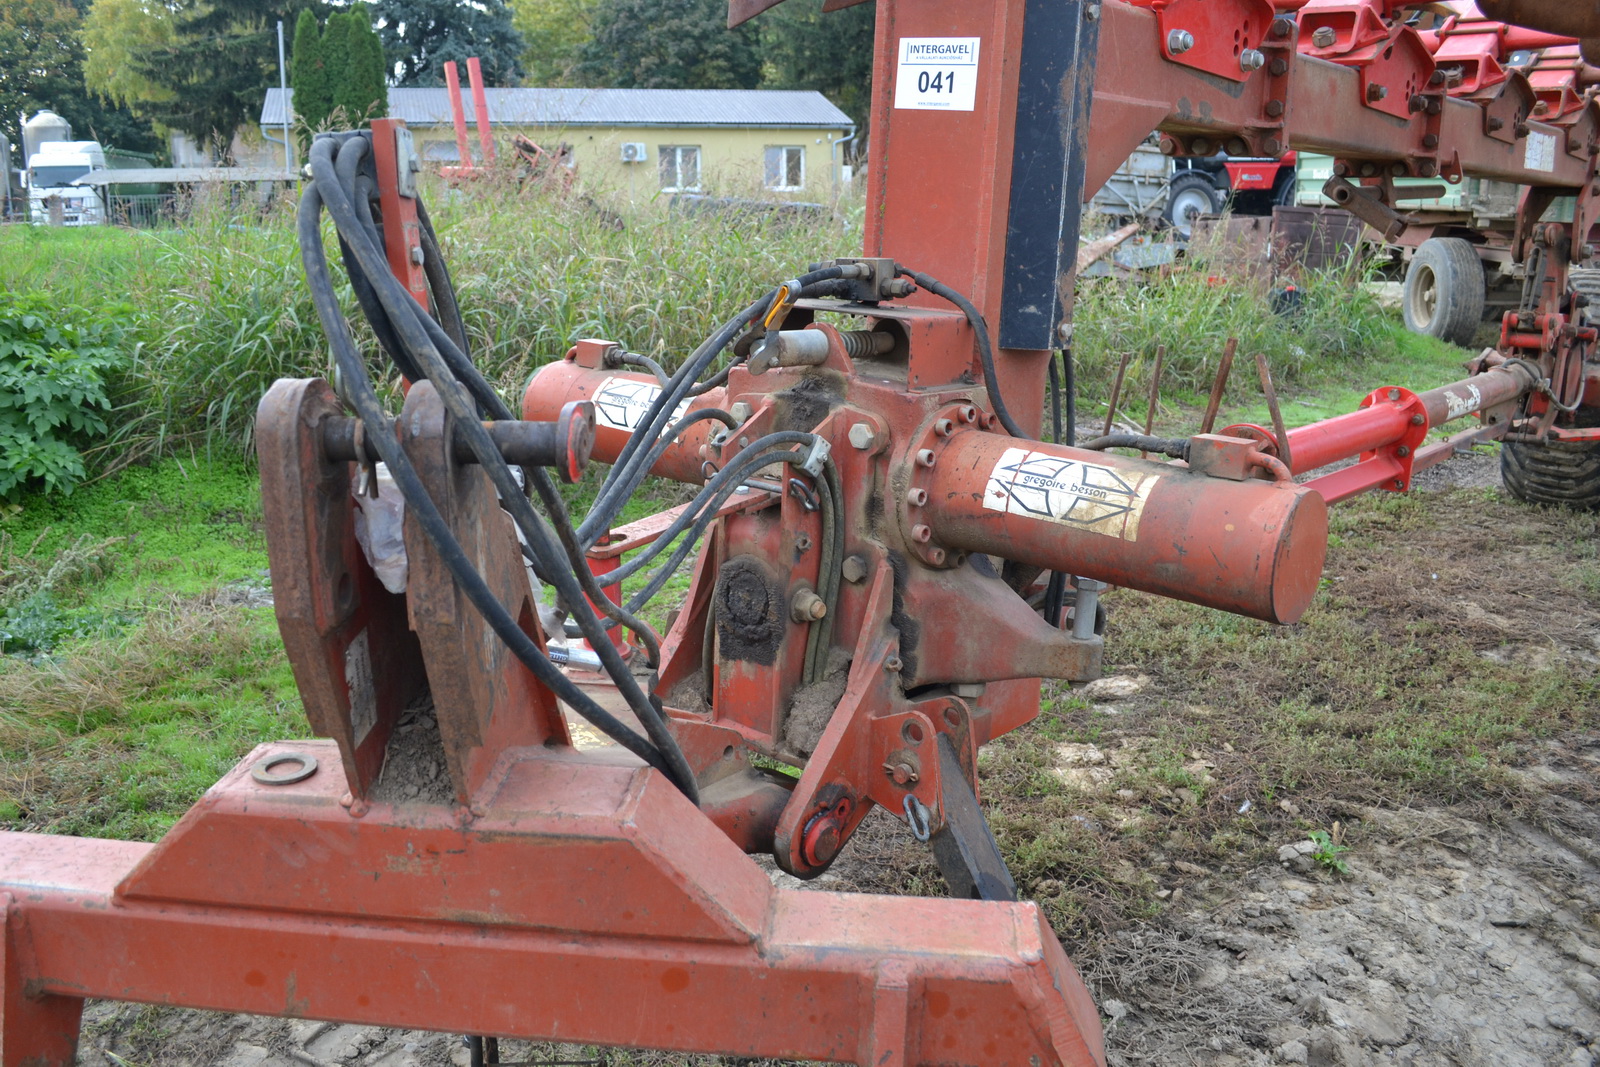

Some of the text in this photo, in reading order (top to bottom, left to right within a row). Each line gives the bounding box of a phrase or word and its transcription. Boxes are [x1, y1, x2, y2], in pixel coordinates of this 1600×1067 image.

[910, 45, 969, 54] INTERGAVEL
[918, 71, 954, 93] 041
[1023, 475, 1107, 499] gregoire besson
